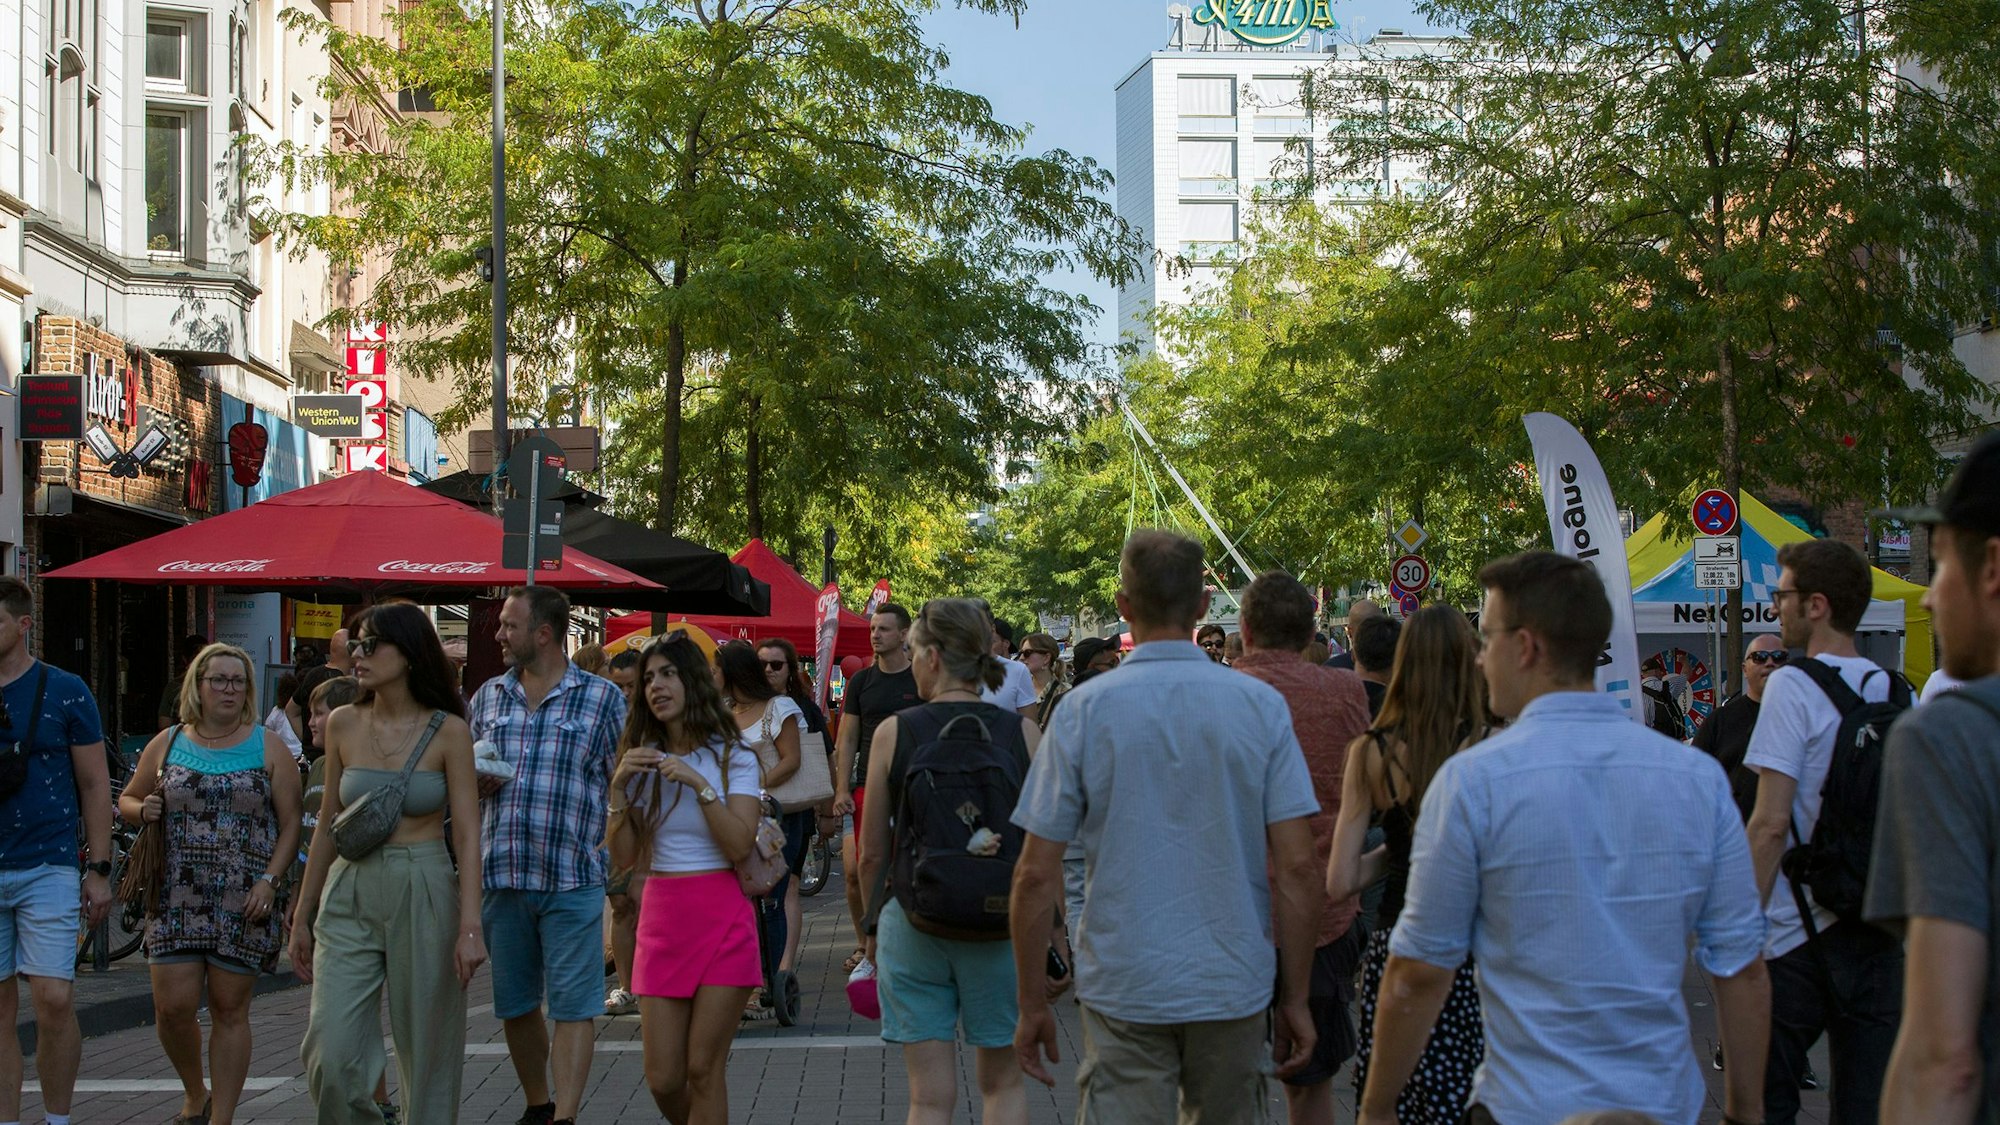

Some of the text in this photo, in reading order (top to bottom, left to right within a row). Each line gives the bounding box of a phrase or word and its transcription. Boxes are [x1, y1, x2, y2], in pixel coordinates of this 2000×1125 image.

[298, 408, 339, 417] Western
[311, 416, 340, 426] Union
[1880, 535, 1910, 545] SISMU
[157, 559, 276, 573] Coca-Cola
[377, 559, 496, 574] Coca-Cola
[1400, 565, 1422, 582] 30
[217, 599, 255, 609] orona
[303, 609, 334, 618] DHL
[1673, 602, 1779, 623] Netolo
